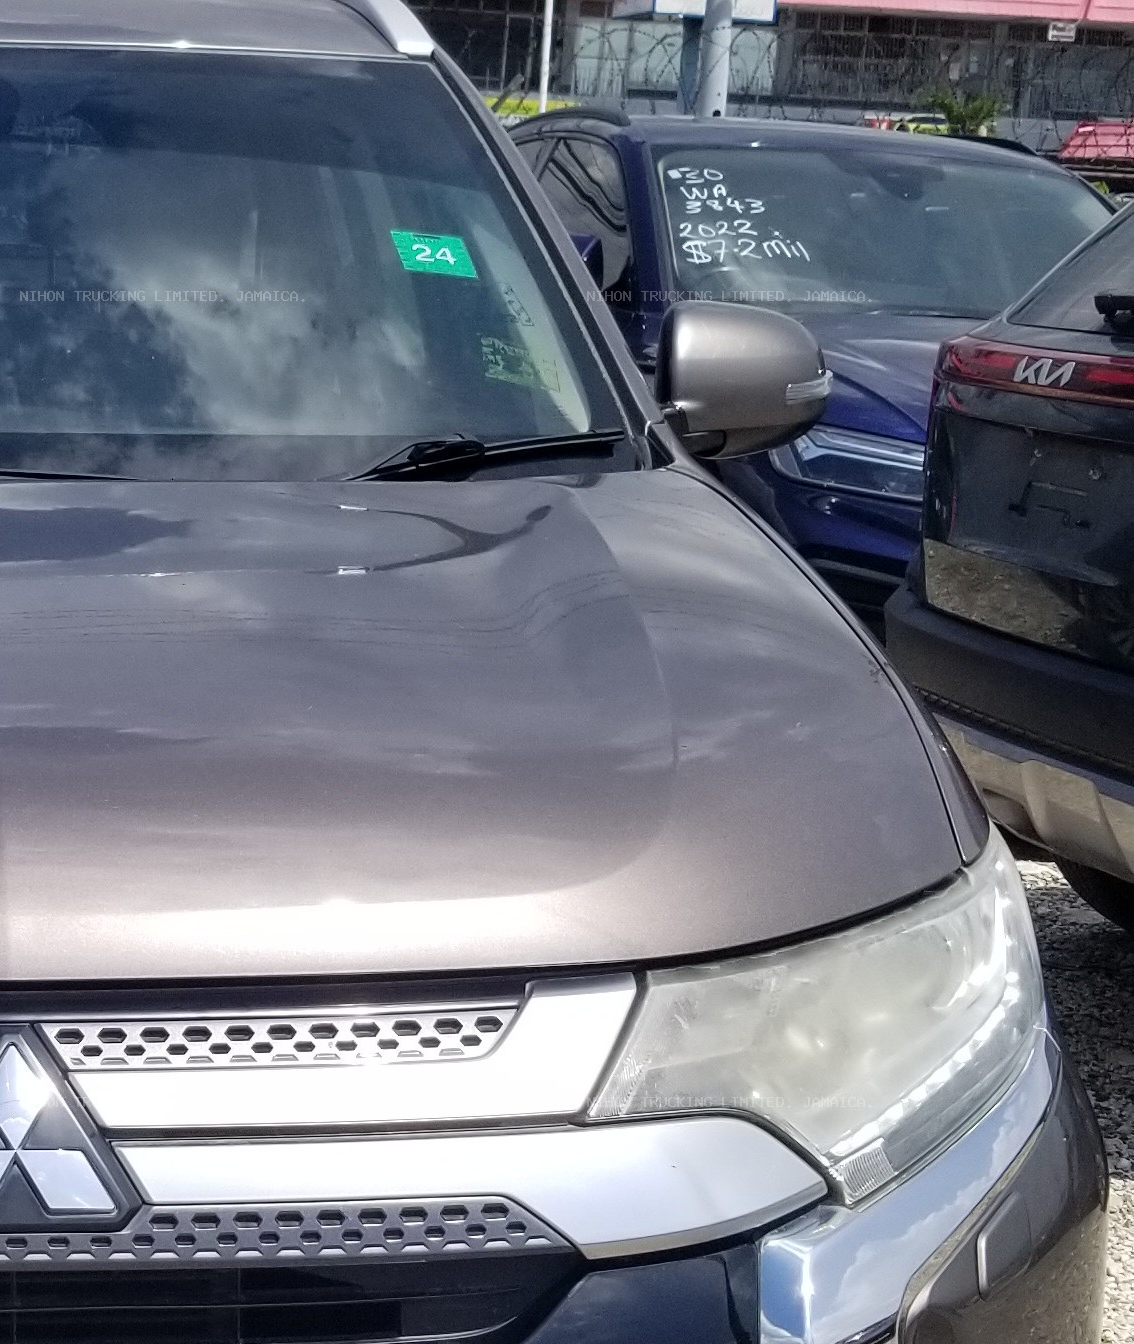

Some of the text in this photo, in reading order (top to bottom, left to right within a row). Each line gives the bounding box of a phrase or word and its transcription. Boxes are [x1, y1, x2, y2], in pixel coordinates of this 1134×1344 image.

[686, 197, 766, 214] 3843
[679, 219, 758, 238] 2022
[411, 243, 457, 265] 24
